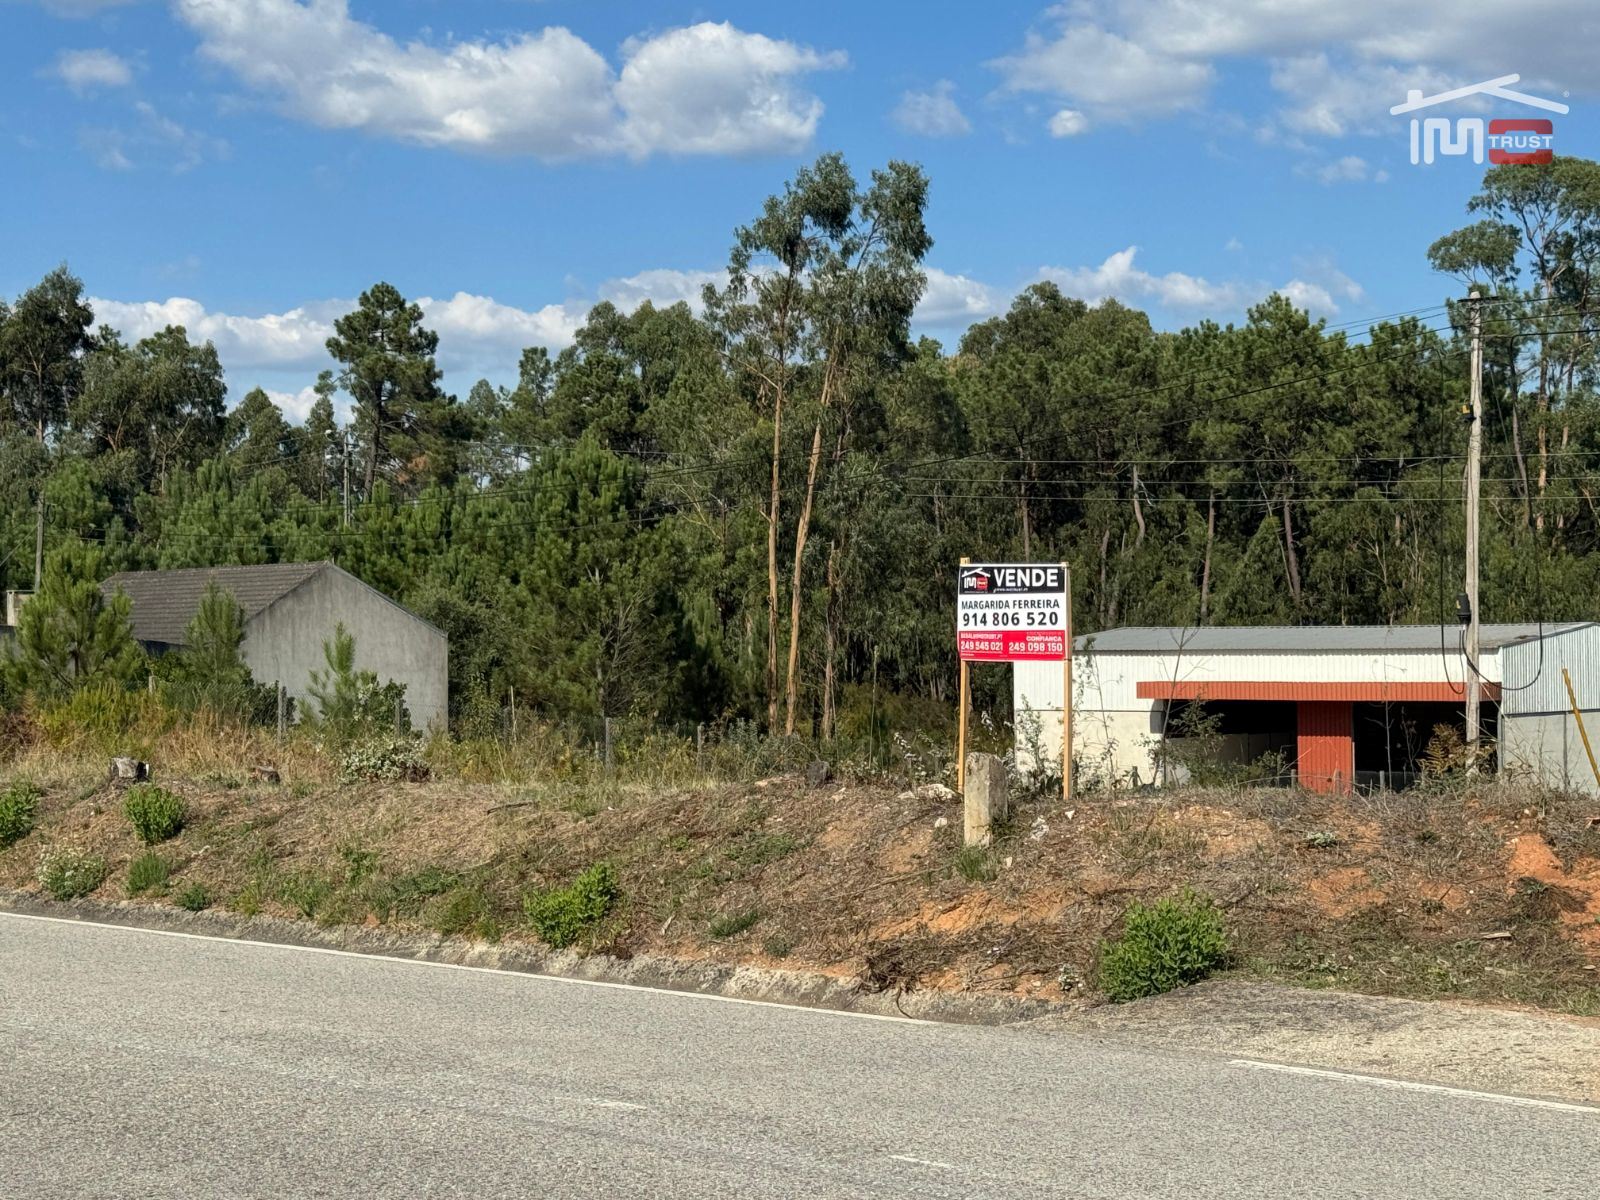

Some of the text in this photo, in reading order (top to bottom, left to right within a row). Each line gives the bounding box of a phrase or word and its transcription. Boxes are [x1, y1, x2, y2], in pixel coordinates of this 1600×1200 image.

[994, 568, 1058, 587] VENDE
[961, 599, 1060, 610] MARGARIDA FERREIRA
[963, 611, 1059, 627] 914 806 520
[960, 641, 974, 651] 249
[990, 642, 1004, 651] 021
[1008, 642, 1025, 652] 249
[1027, 642, 1045, 652] 098
